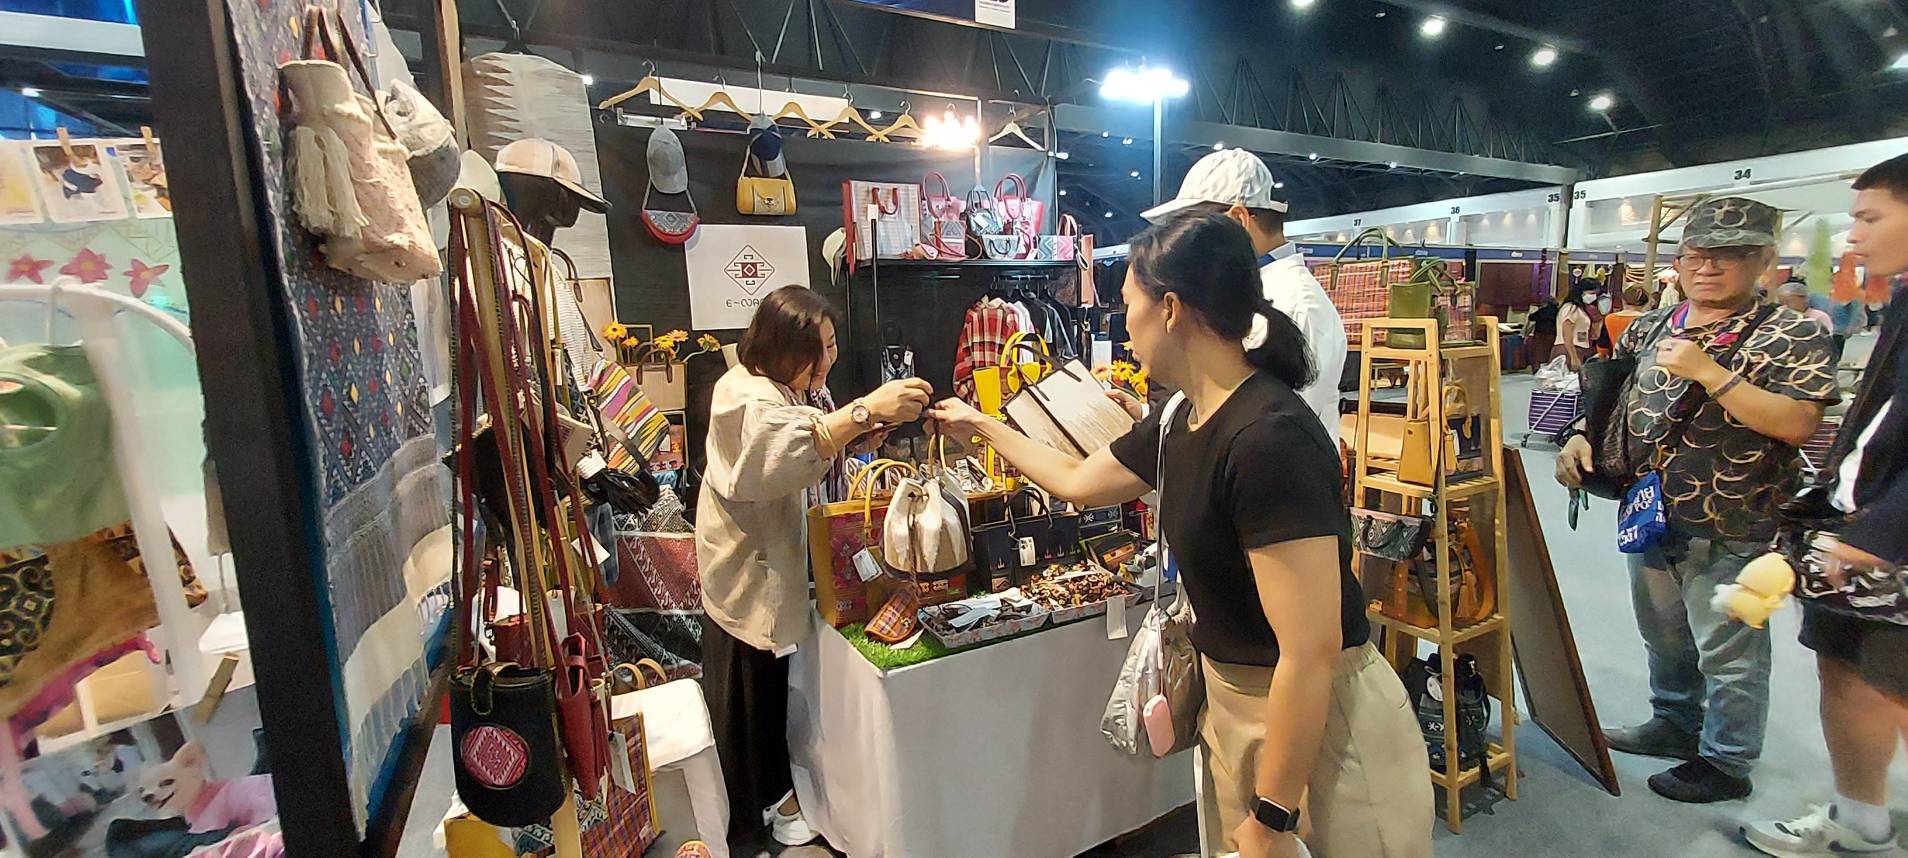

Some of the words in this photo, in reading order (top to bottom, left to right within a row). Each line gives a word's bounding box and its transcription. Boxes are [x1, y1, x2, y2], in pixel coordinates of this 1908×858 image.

[1734, 168, 1751, 180] 34
[1548, 193, 1560, 203] 35
[1574, 190, 1586, 200] 35
[1450, 206, 1460, 214] 36
[1353, 218, 1361, 226] 37
